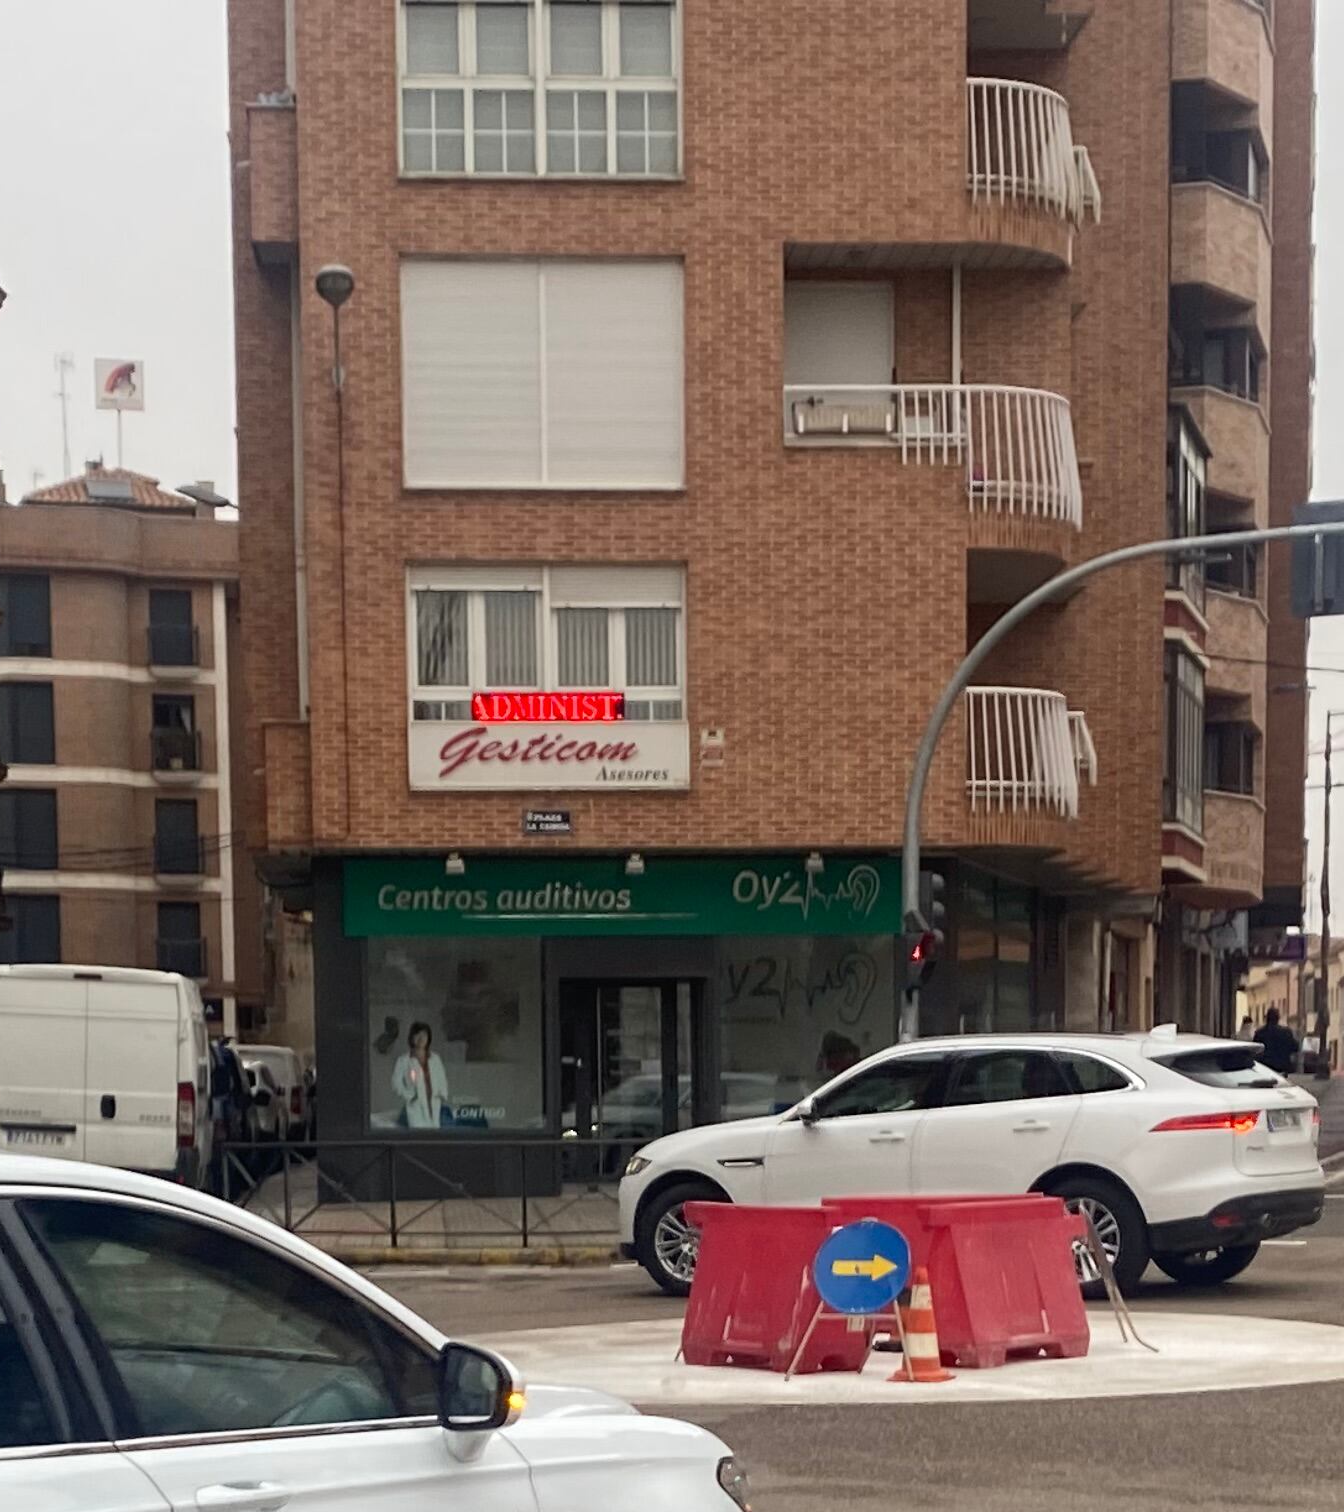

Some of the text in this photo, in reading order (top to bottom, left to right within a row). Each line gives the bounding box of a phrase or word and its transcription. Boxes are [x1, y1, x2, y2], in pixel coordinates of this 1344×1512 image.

[438, 727, 639, 778] Gesticom
[596, 767, 670, 782] Asesores
[378, 881, 631, 911] Centros auditivos
